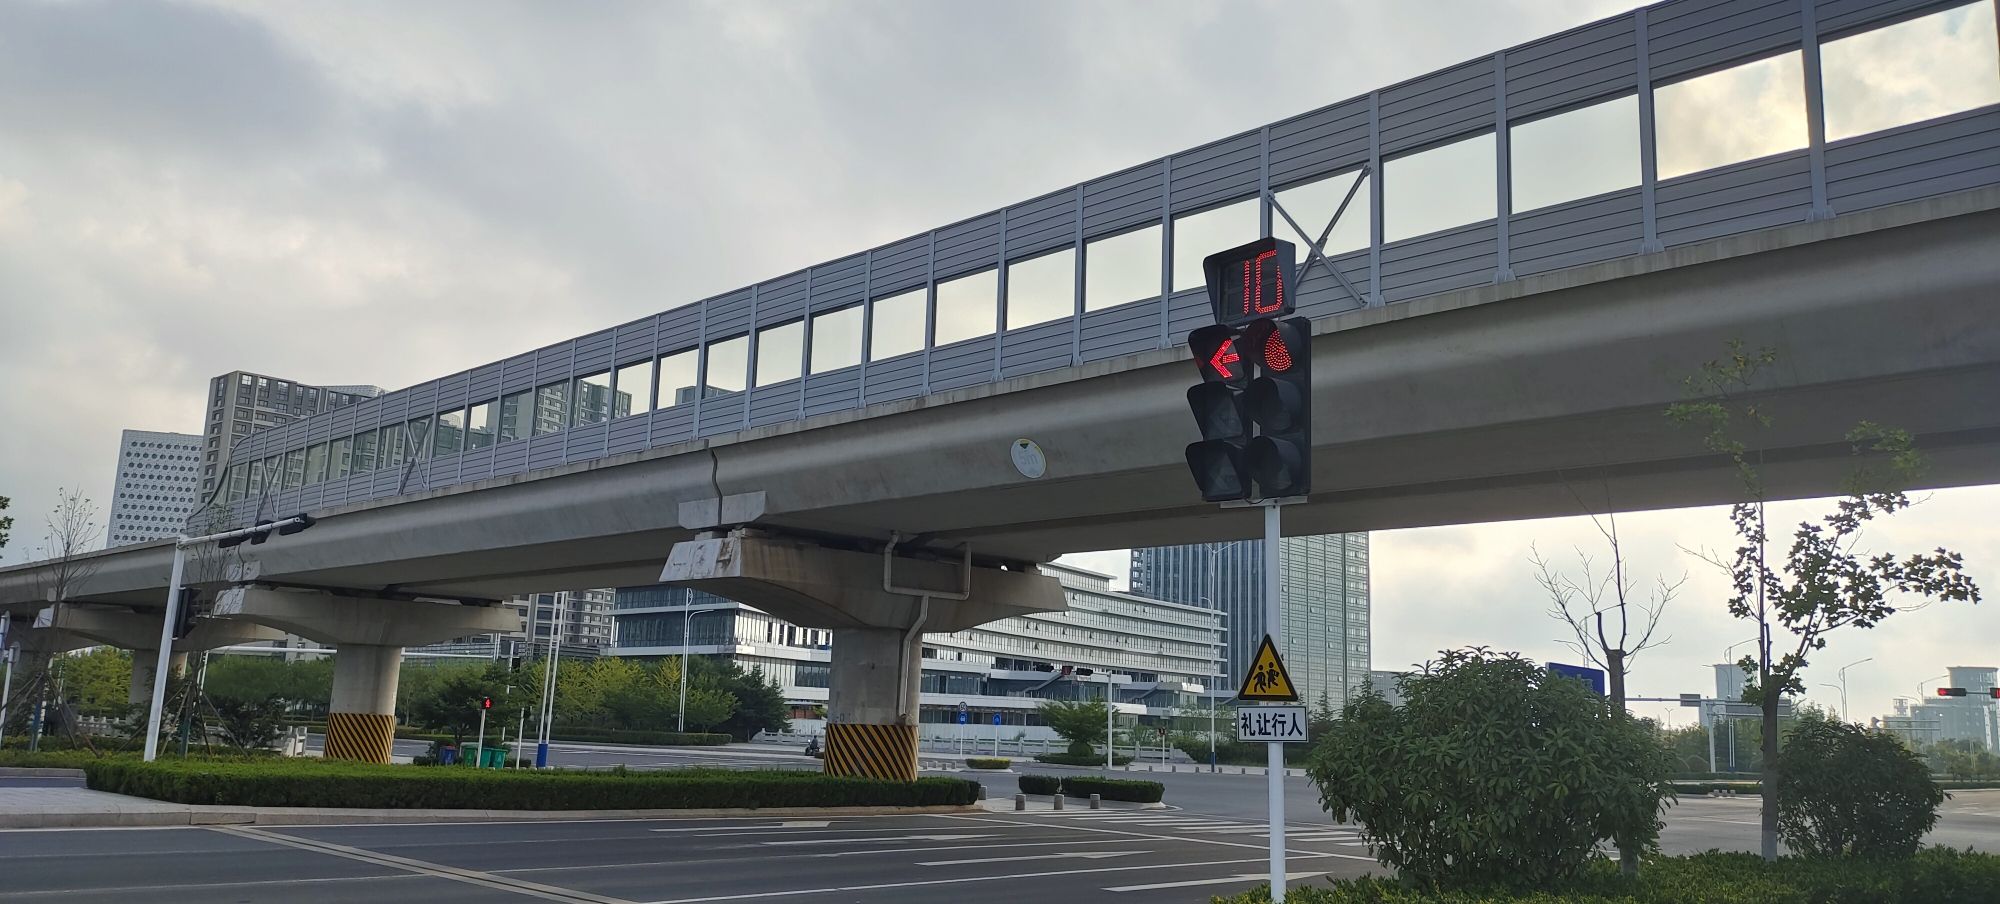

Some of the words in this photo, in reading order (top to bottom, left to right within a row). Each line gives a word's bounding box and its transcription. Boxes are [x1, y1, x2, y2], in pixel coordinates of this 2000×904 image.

[1244, 249, 1283, 315] 10
[1241, 712, 1303, 737] 礼让行人
